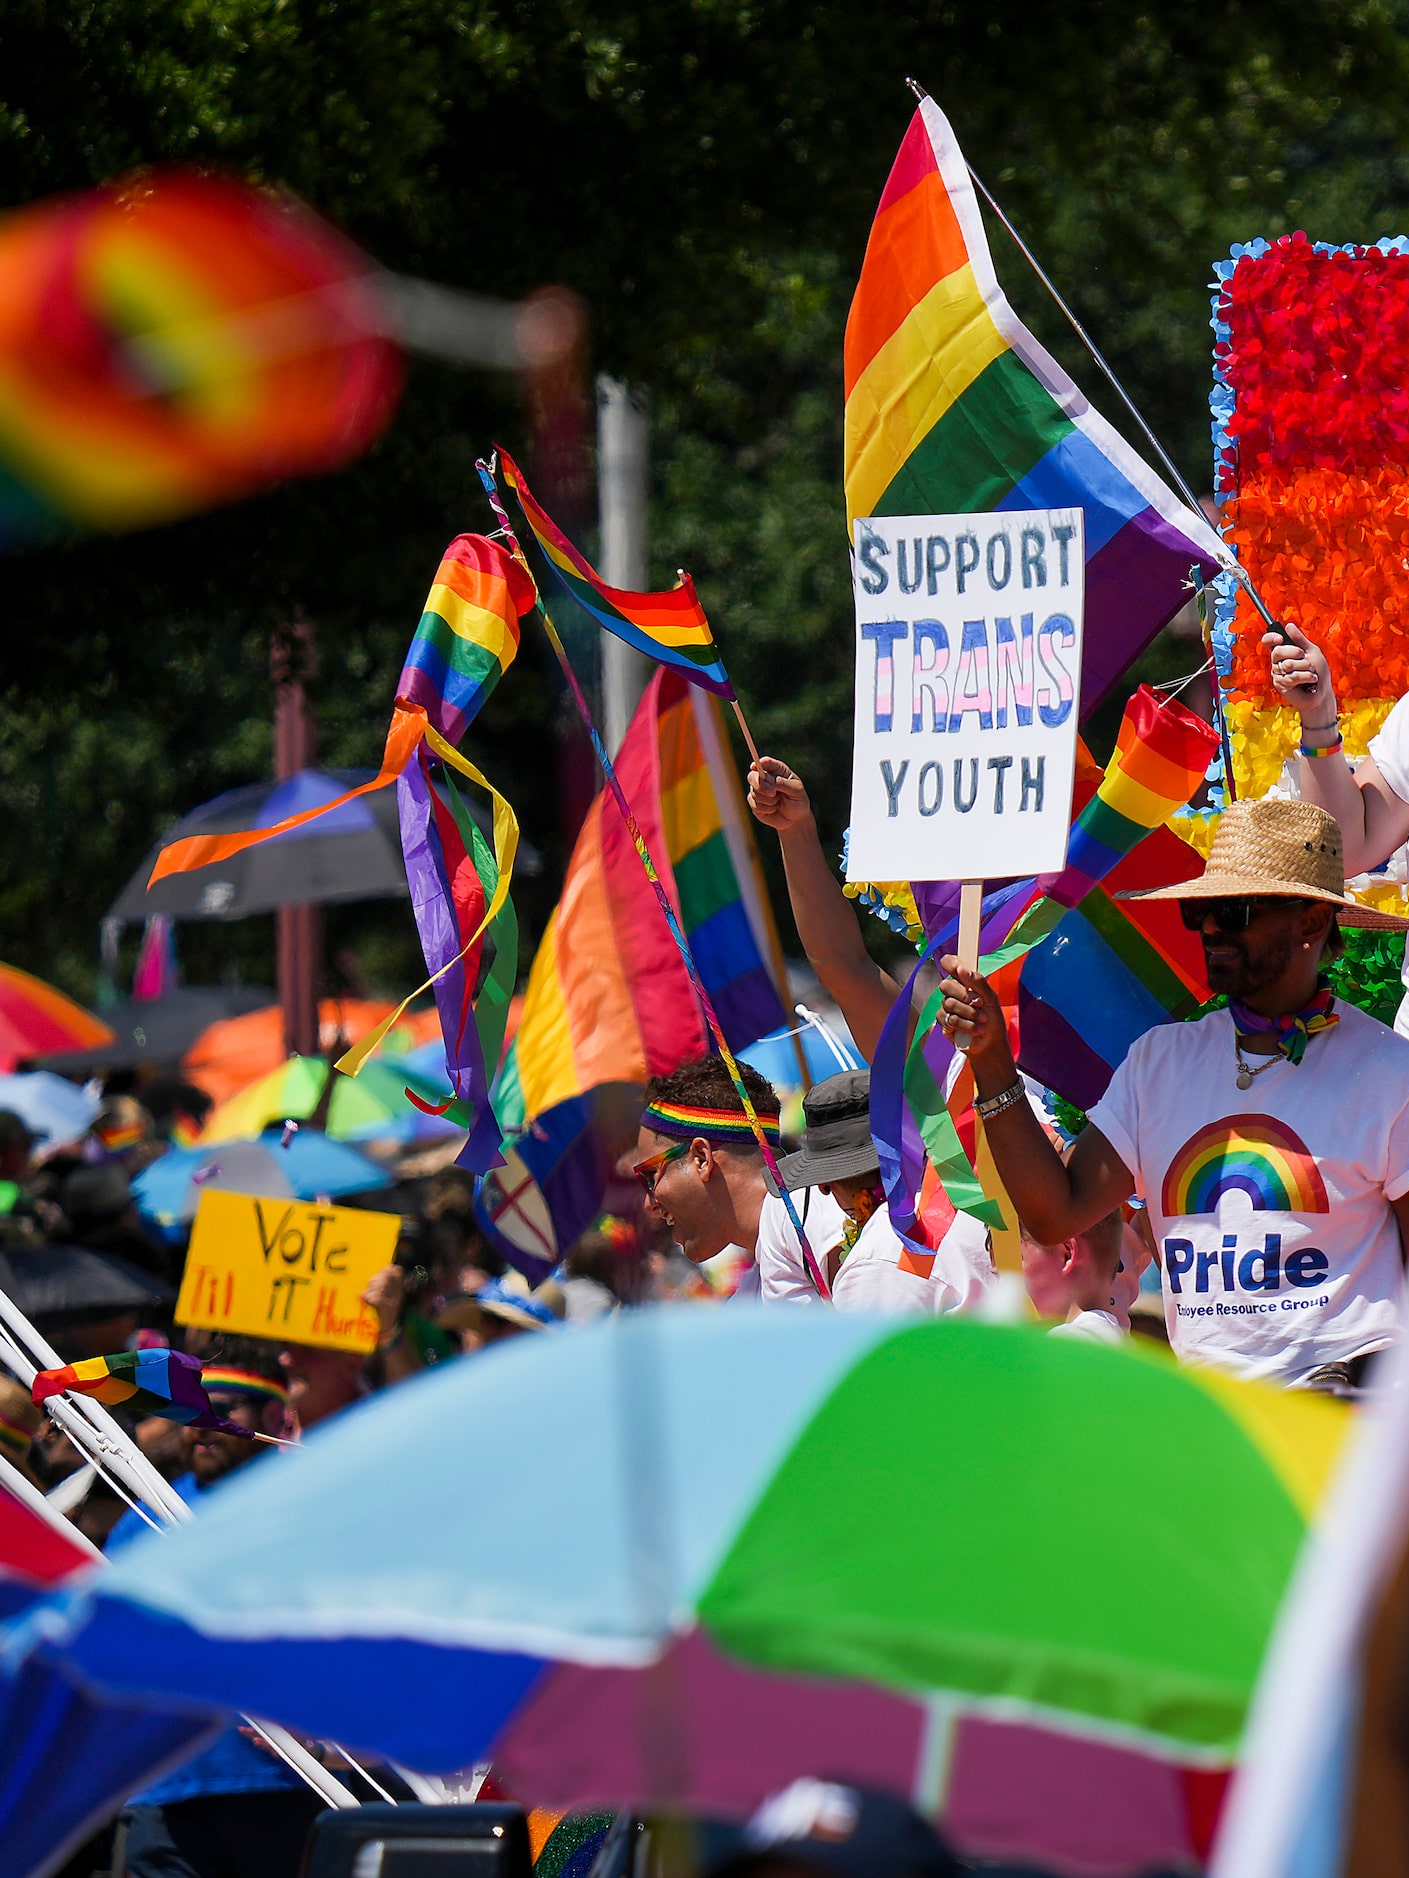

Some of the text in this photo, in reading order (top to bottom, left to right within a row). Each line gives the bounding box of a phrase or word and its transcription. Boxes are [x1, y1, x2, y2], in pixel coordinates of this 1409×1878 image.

[860, 526, 1076, 596] SUPPORT
[861, 612, 1074, 734] TRANS
[879, 756, 1046, 817] YOUTH
[1164, 1233, 1329, 1294] Pride
[1216, 1302, 1277, 1316] Resource
[1281, 1294, 1329, 1311] Group
